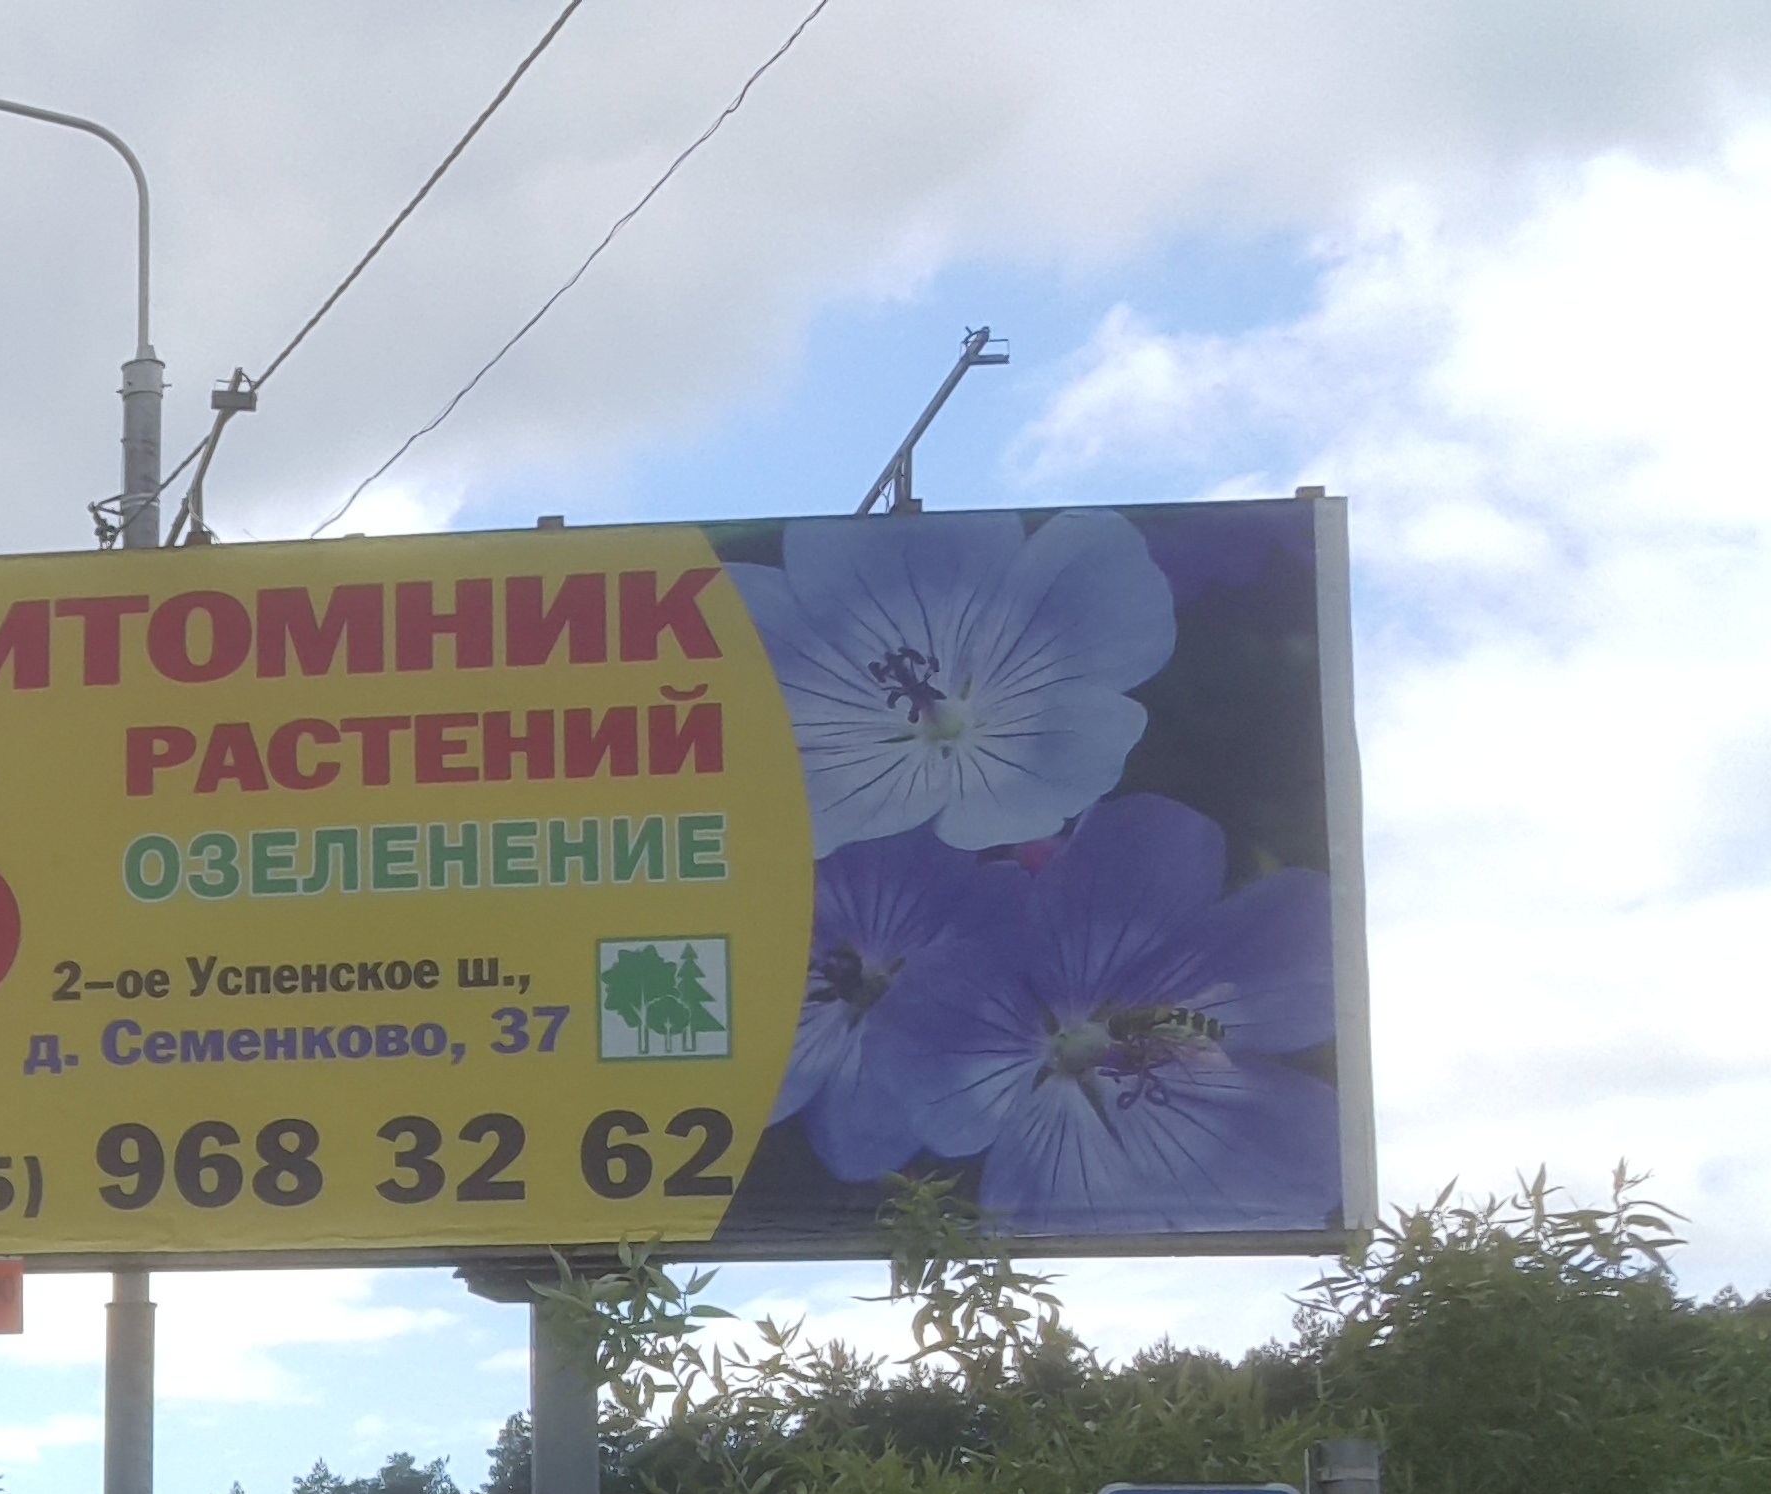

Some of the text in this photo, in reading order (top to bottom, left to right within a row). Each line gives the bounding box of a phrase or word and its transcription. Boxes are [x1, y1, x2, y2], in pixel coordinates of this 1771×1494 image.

[126, 683, 724, 797] РАСТЕНИЙ
[122, 812, 729, 902] ОЗЕЛЕНЕНИЕ
[185, 955, 440, 998] Успенское
[23, 1005, 571, 1075] д. Семенково, 37
[95, 1118, 325, 1212] 968
[375, 1112, 527, 1203] 32
[580, 1106, 736, 1200] 62
